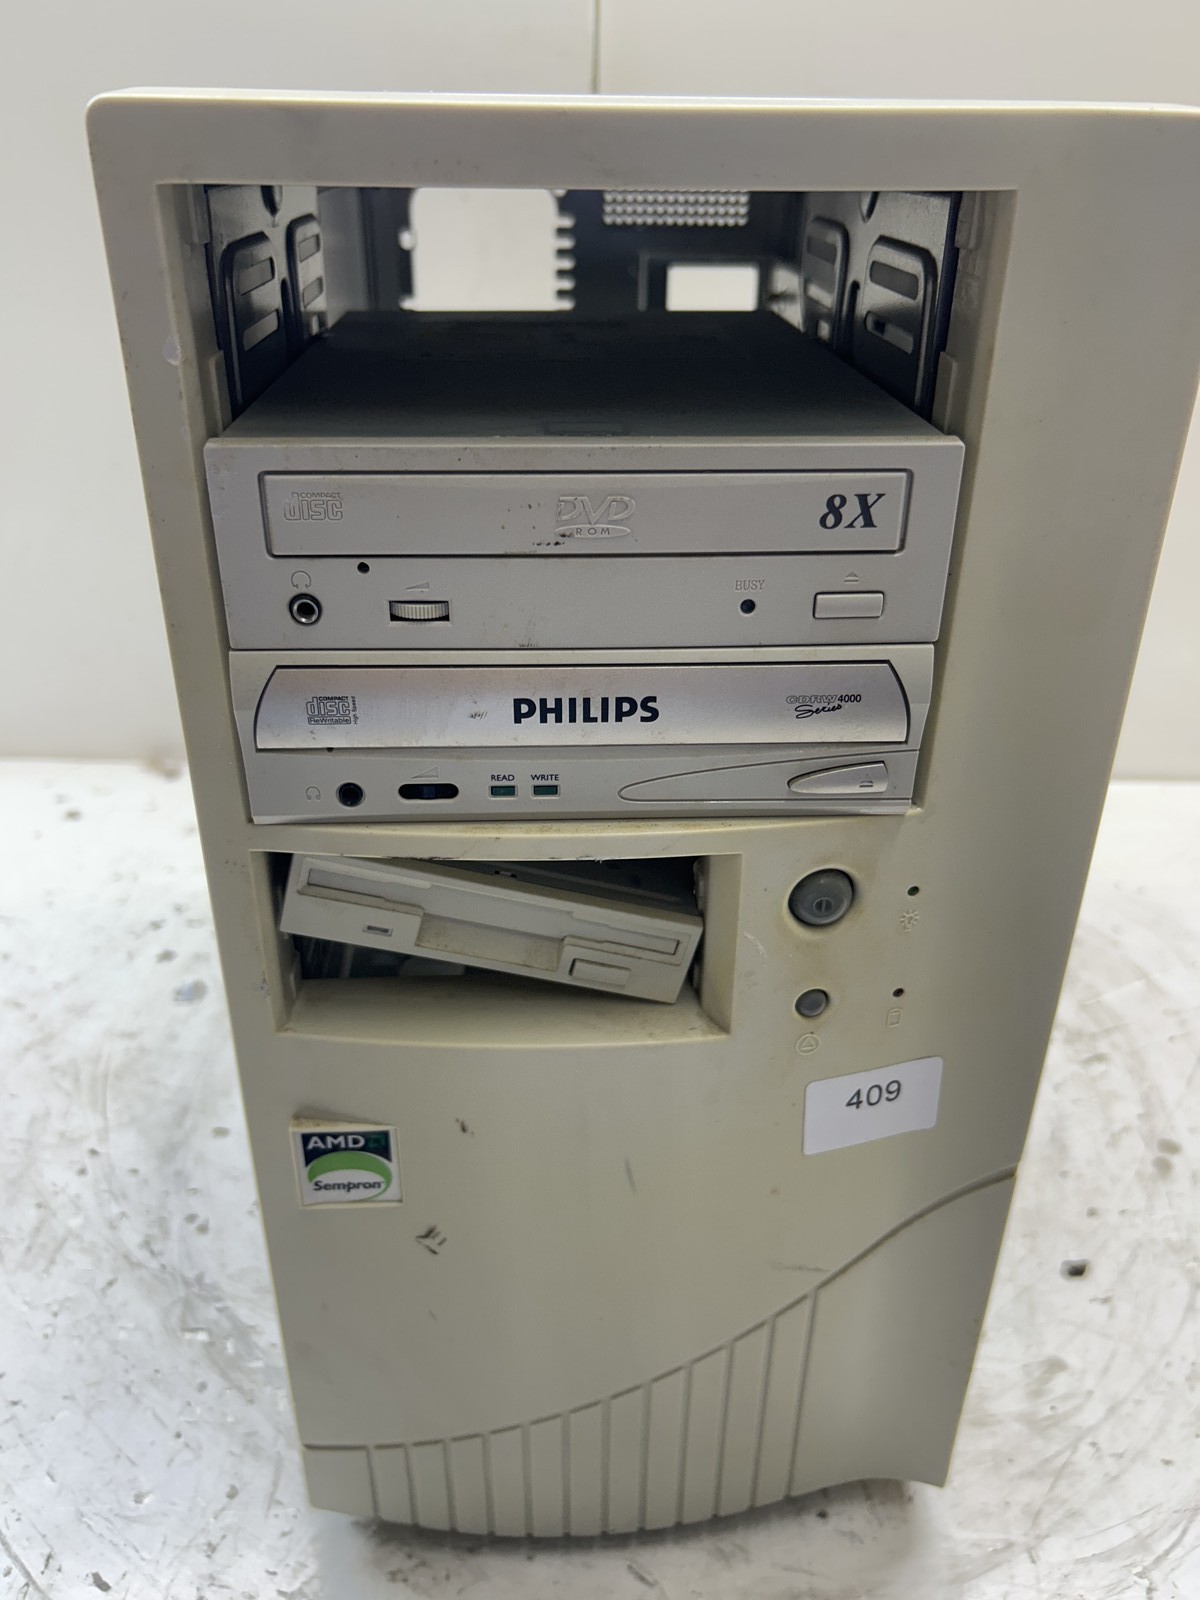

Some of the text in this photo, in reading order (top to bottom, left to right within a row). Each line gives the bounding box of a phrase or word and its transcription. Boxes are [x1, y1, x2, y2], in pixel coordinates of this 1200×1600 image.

[557, 495, 636, 525] DVD
[819, 493, 886, 529] 8X
[575, 527, 610, 536] ROM
[735, 579, 765, 591] BUSY
[513, 696, 660, 724] PHILIPS
[794, 702, 842, 719] Series
[490, 773, 560, 782] READ WRITE
[845, 1079, 902, 1110] 409
[307, 1134, 366, 1150] AMD
[313, 1180, 382, 1193] Sempron
